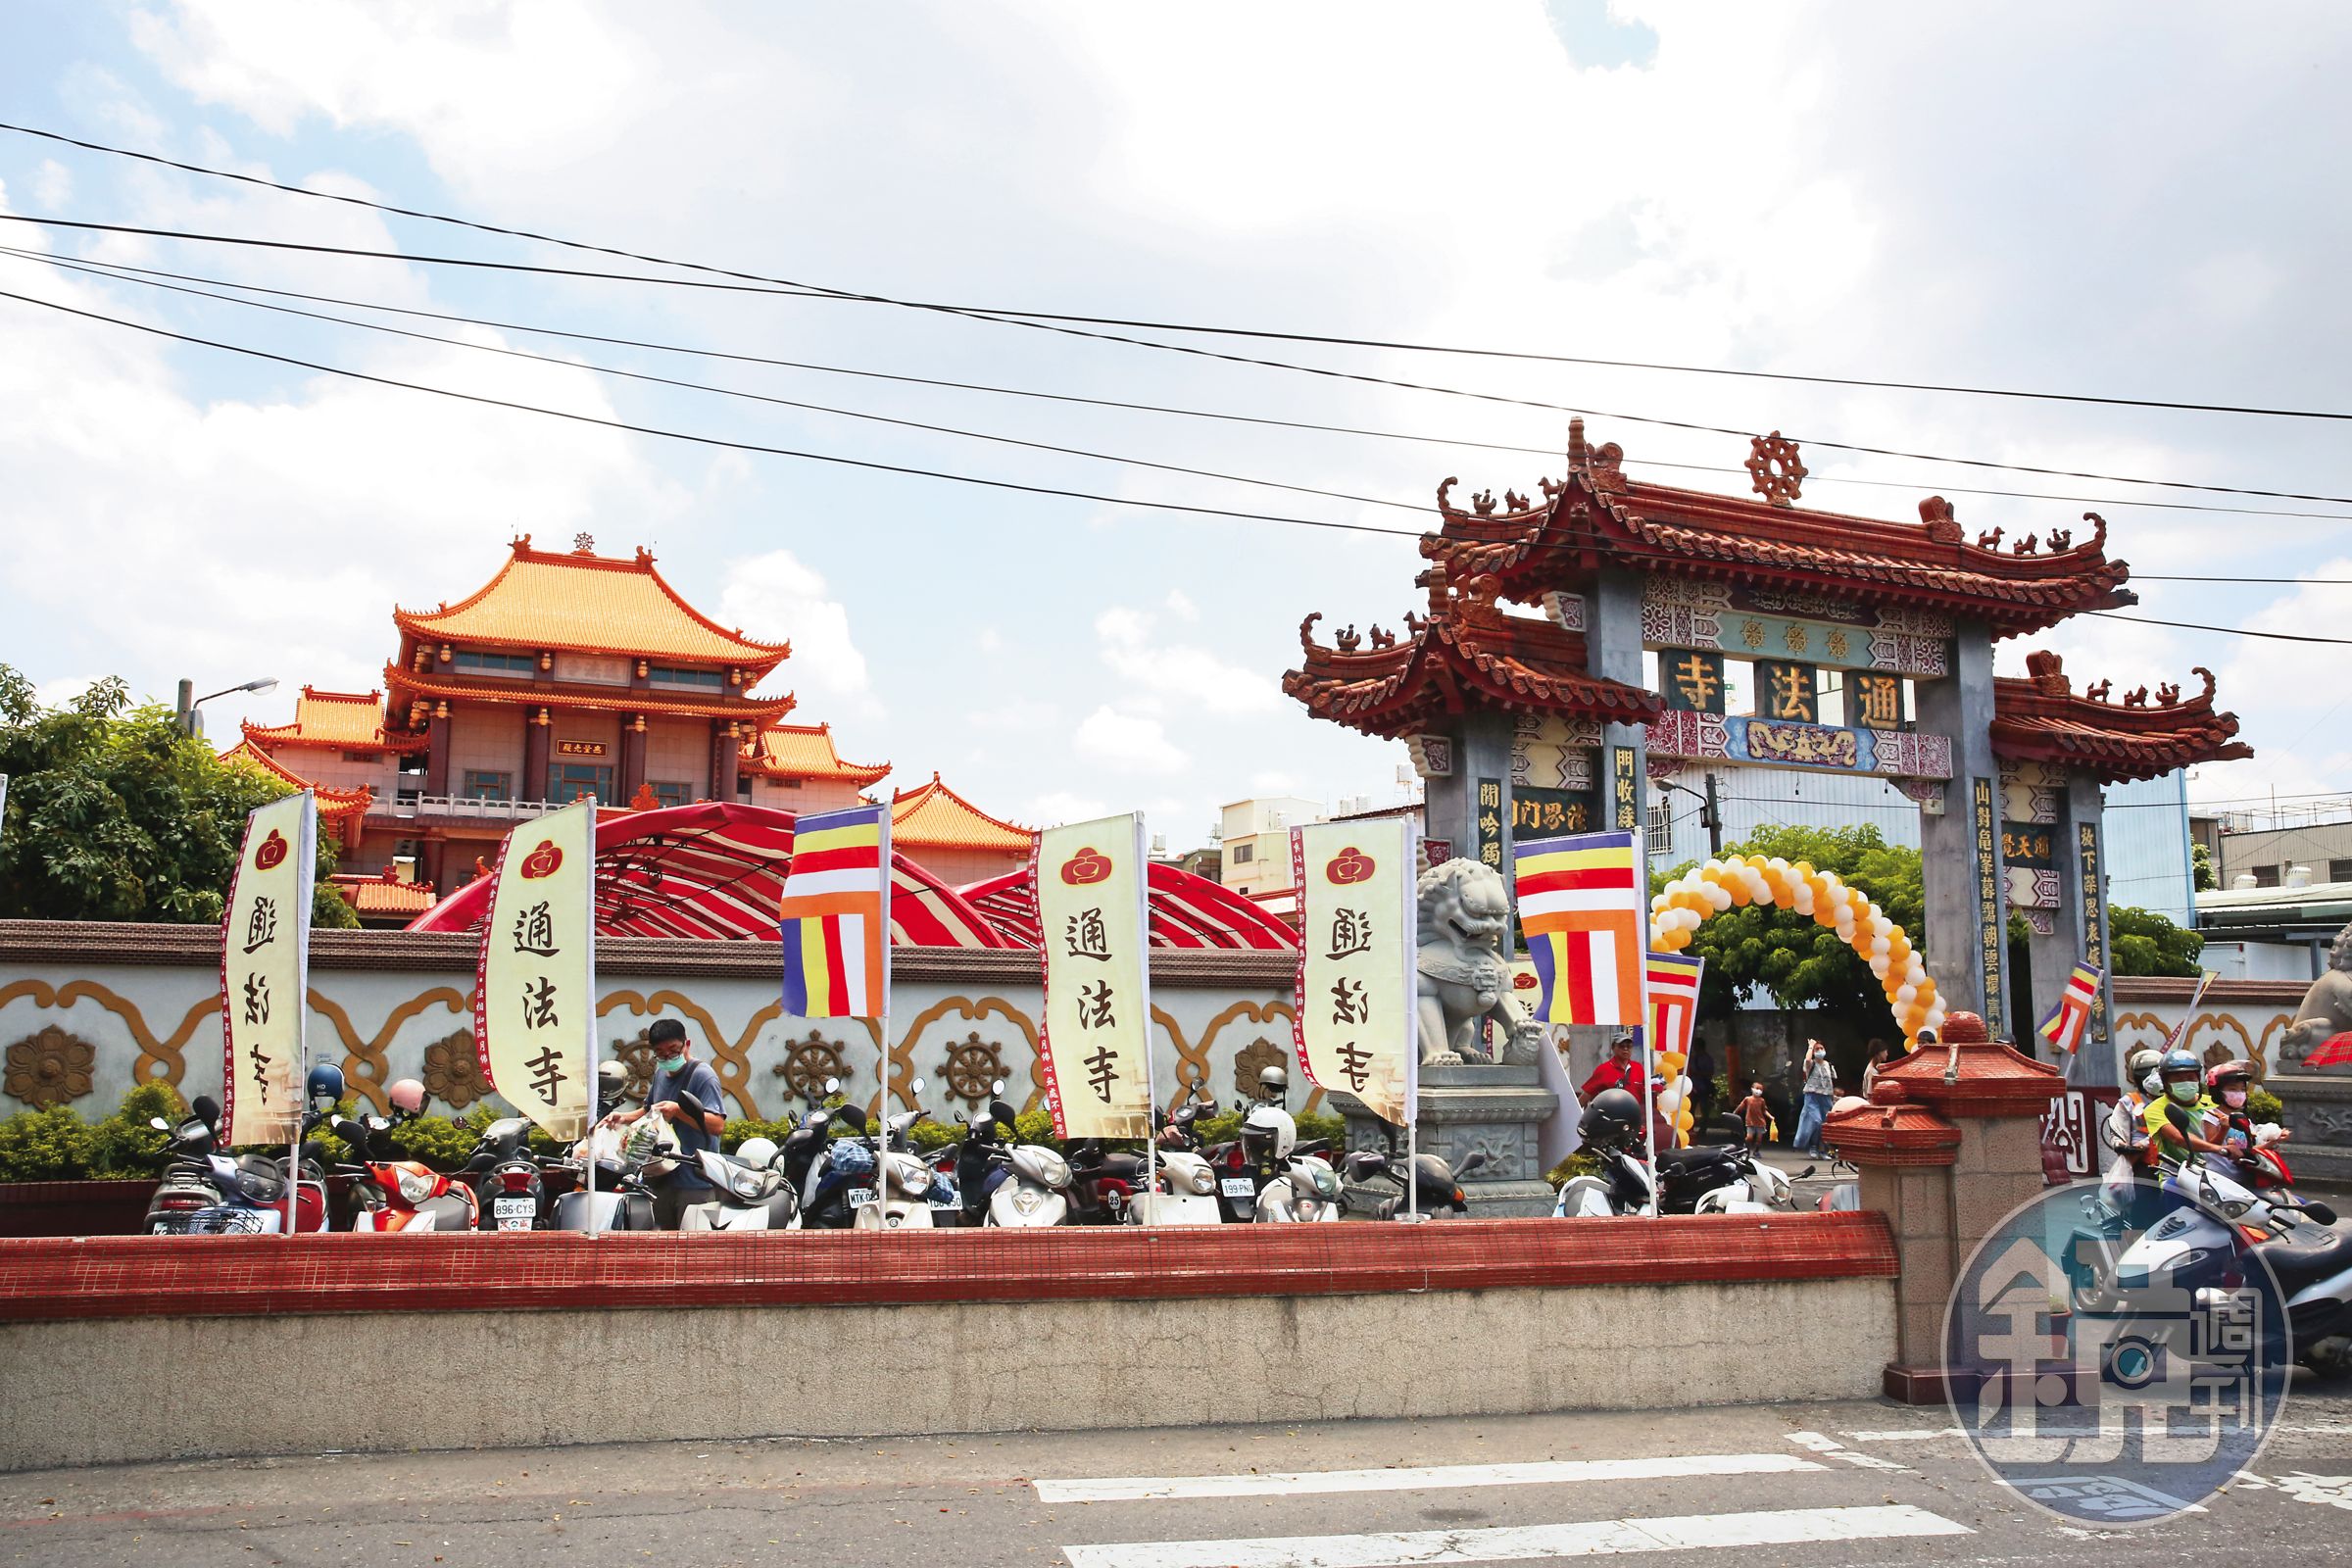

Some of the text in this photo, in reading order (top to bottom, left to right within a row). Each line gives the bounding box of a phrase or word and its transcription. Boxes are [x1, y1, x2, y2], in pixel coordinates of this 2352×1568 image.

[1675, 654, 1899, 731] 通法寺
[514, 901, 568, 1106] 通法寺
[1065, 907, 1119, 1103] 通法寺
[1109, 1196, 1119, 1205] 25
